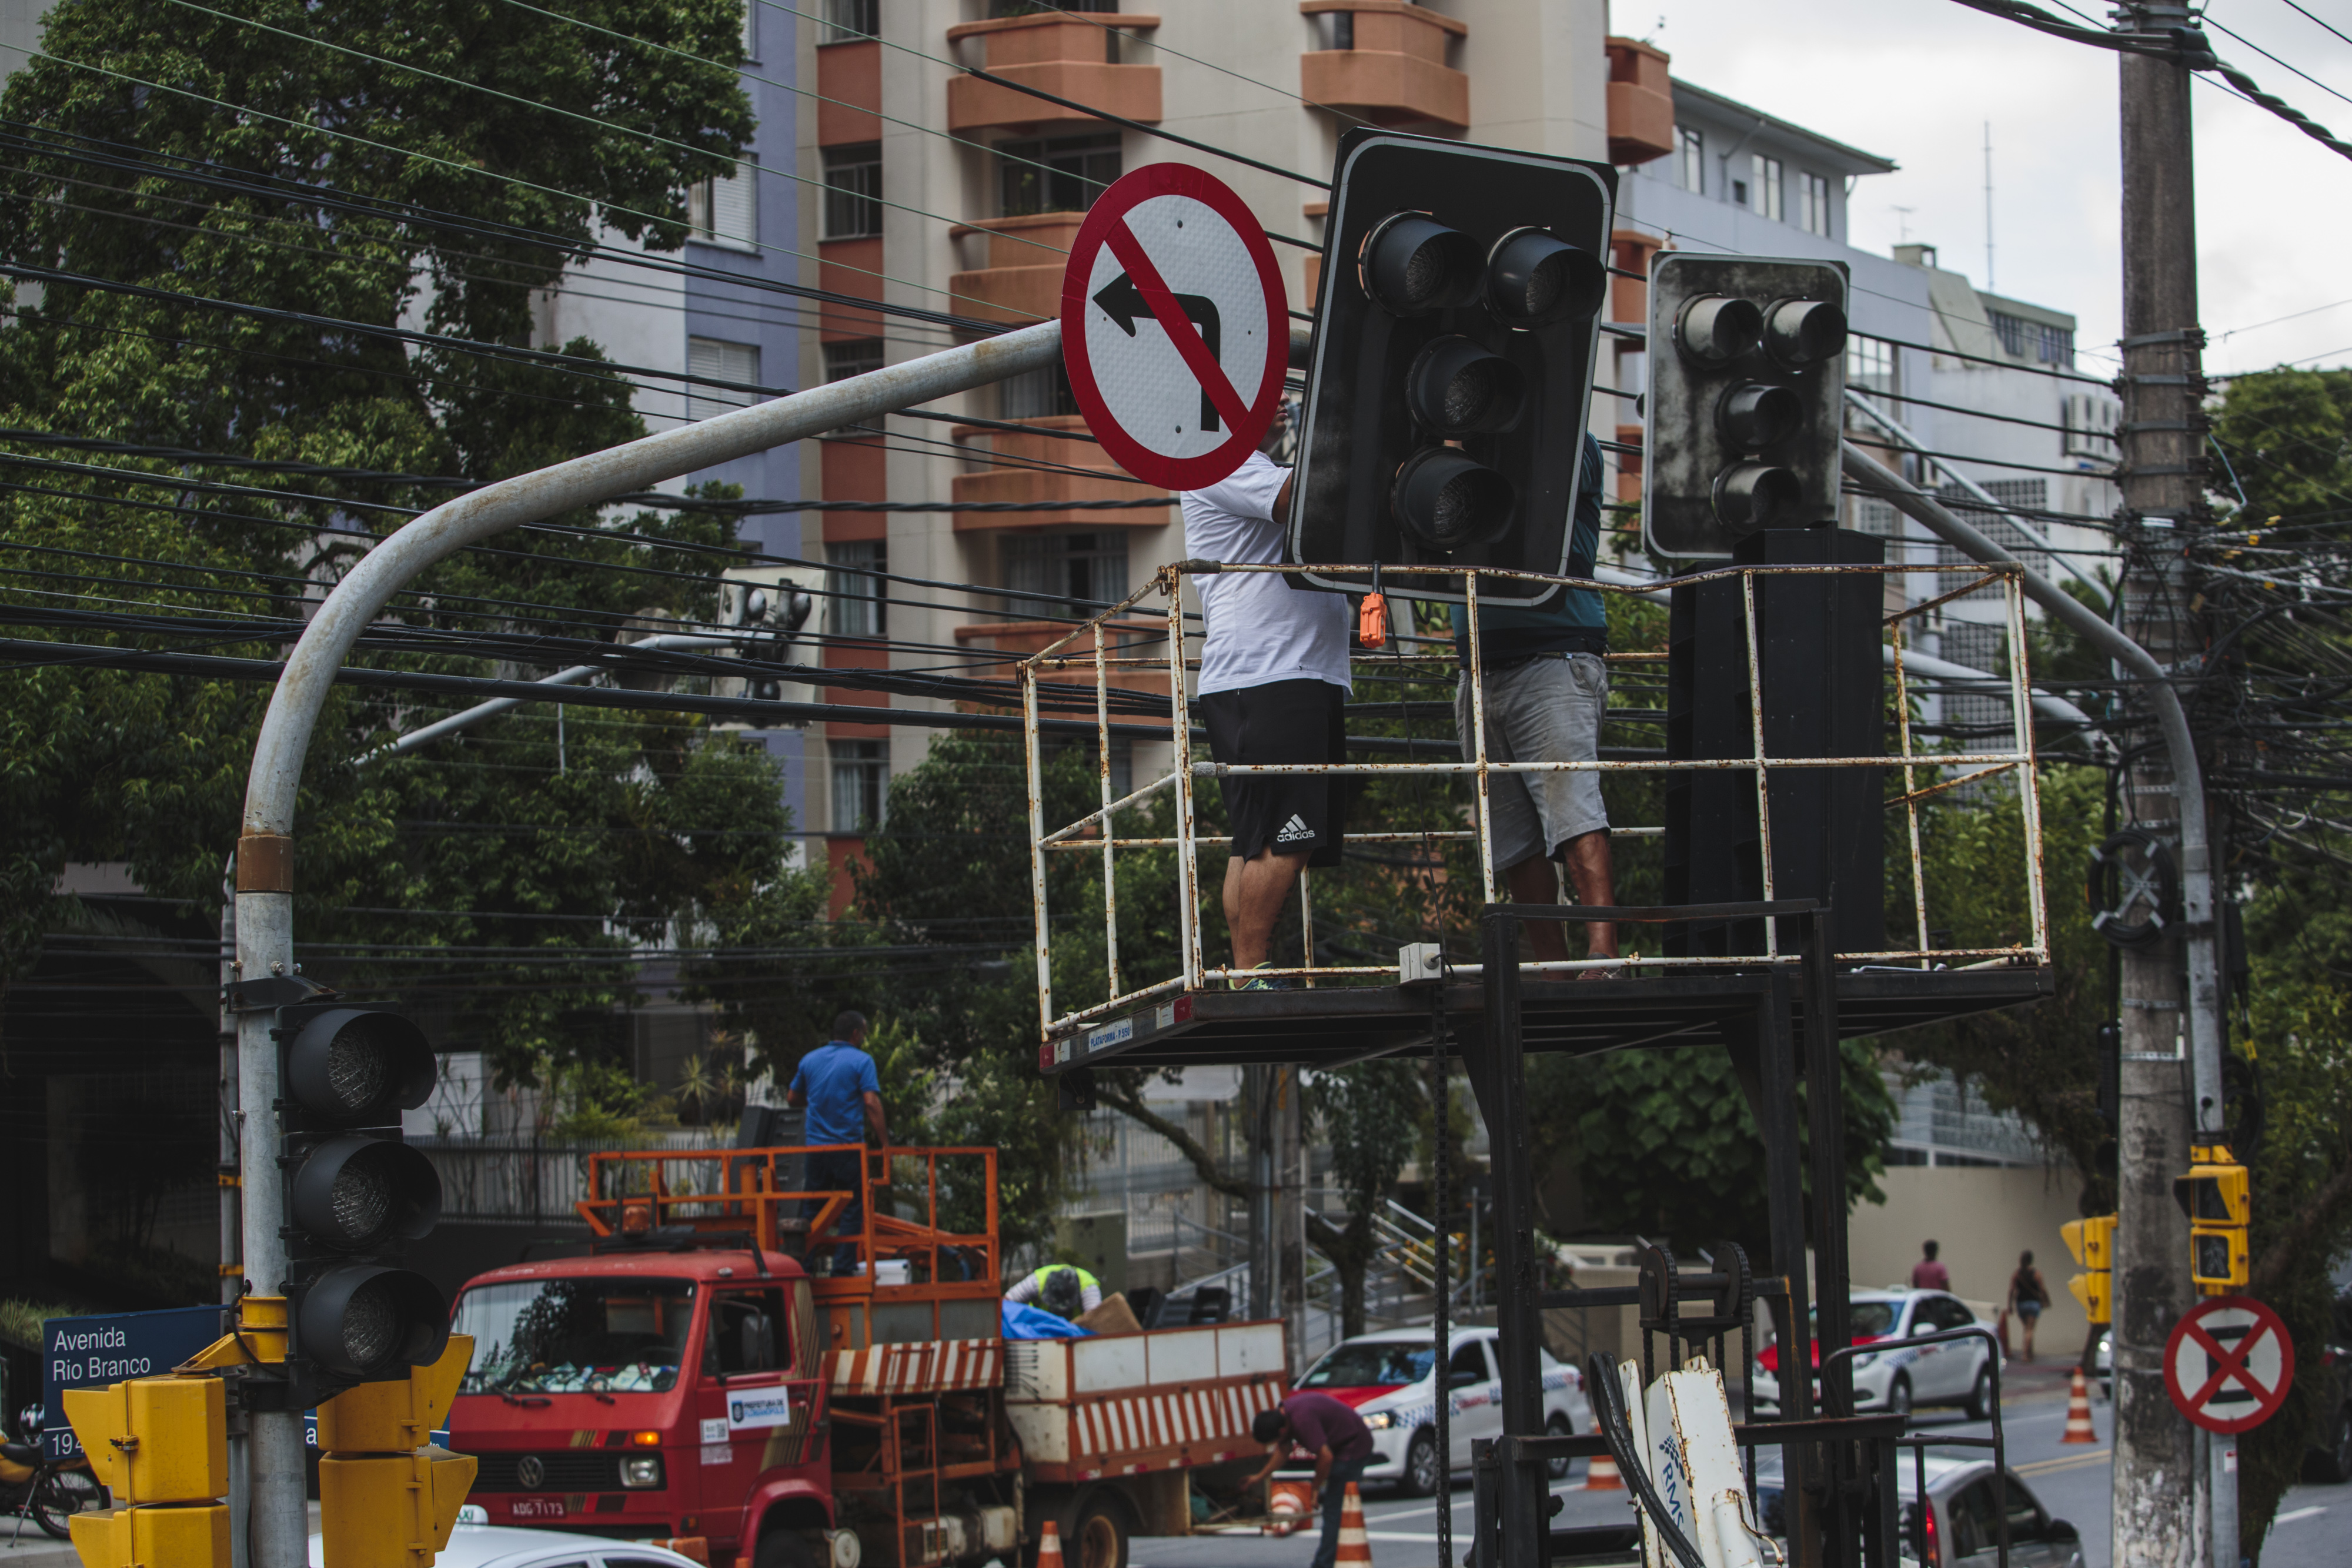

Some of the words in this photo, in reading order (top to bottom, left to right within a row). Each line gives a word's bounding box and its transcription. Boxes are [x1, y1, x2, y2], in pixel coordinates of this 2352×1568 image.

[1277, 830, 1315, 842] adidas
[1091, 1031, 1115, 1047] PLATAFORMA
[54, 1326, 126, 1352] Avenida
[53, 1359, 83, 1381] Rio
[89, 1356, 151, 1378] Branco
